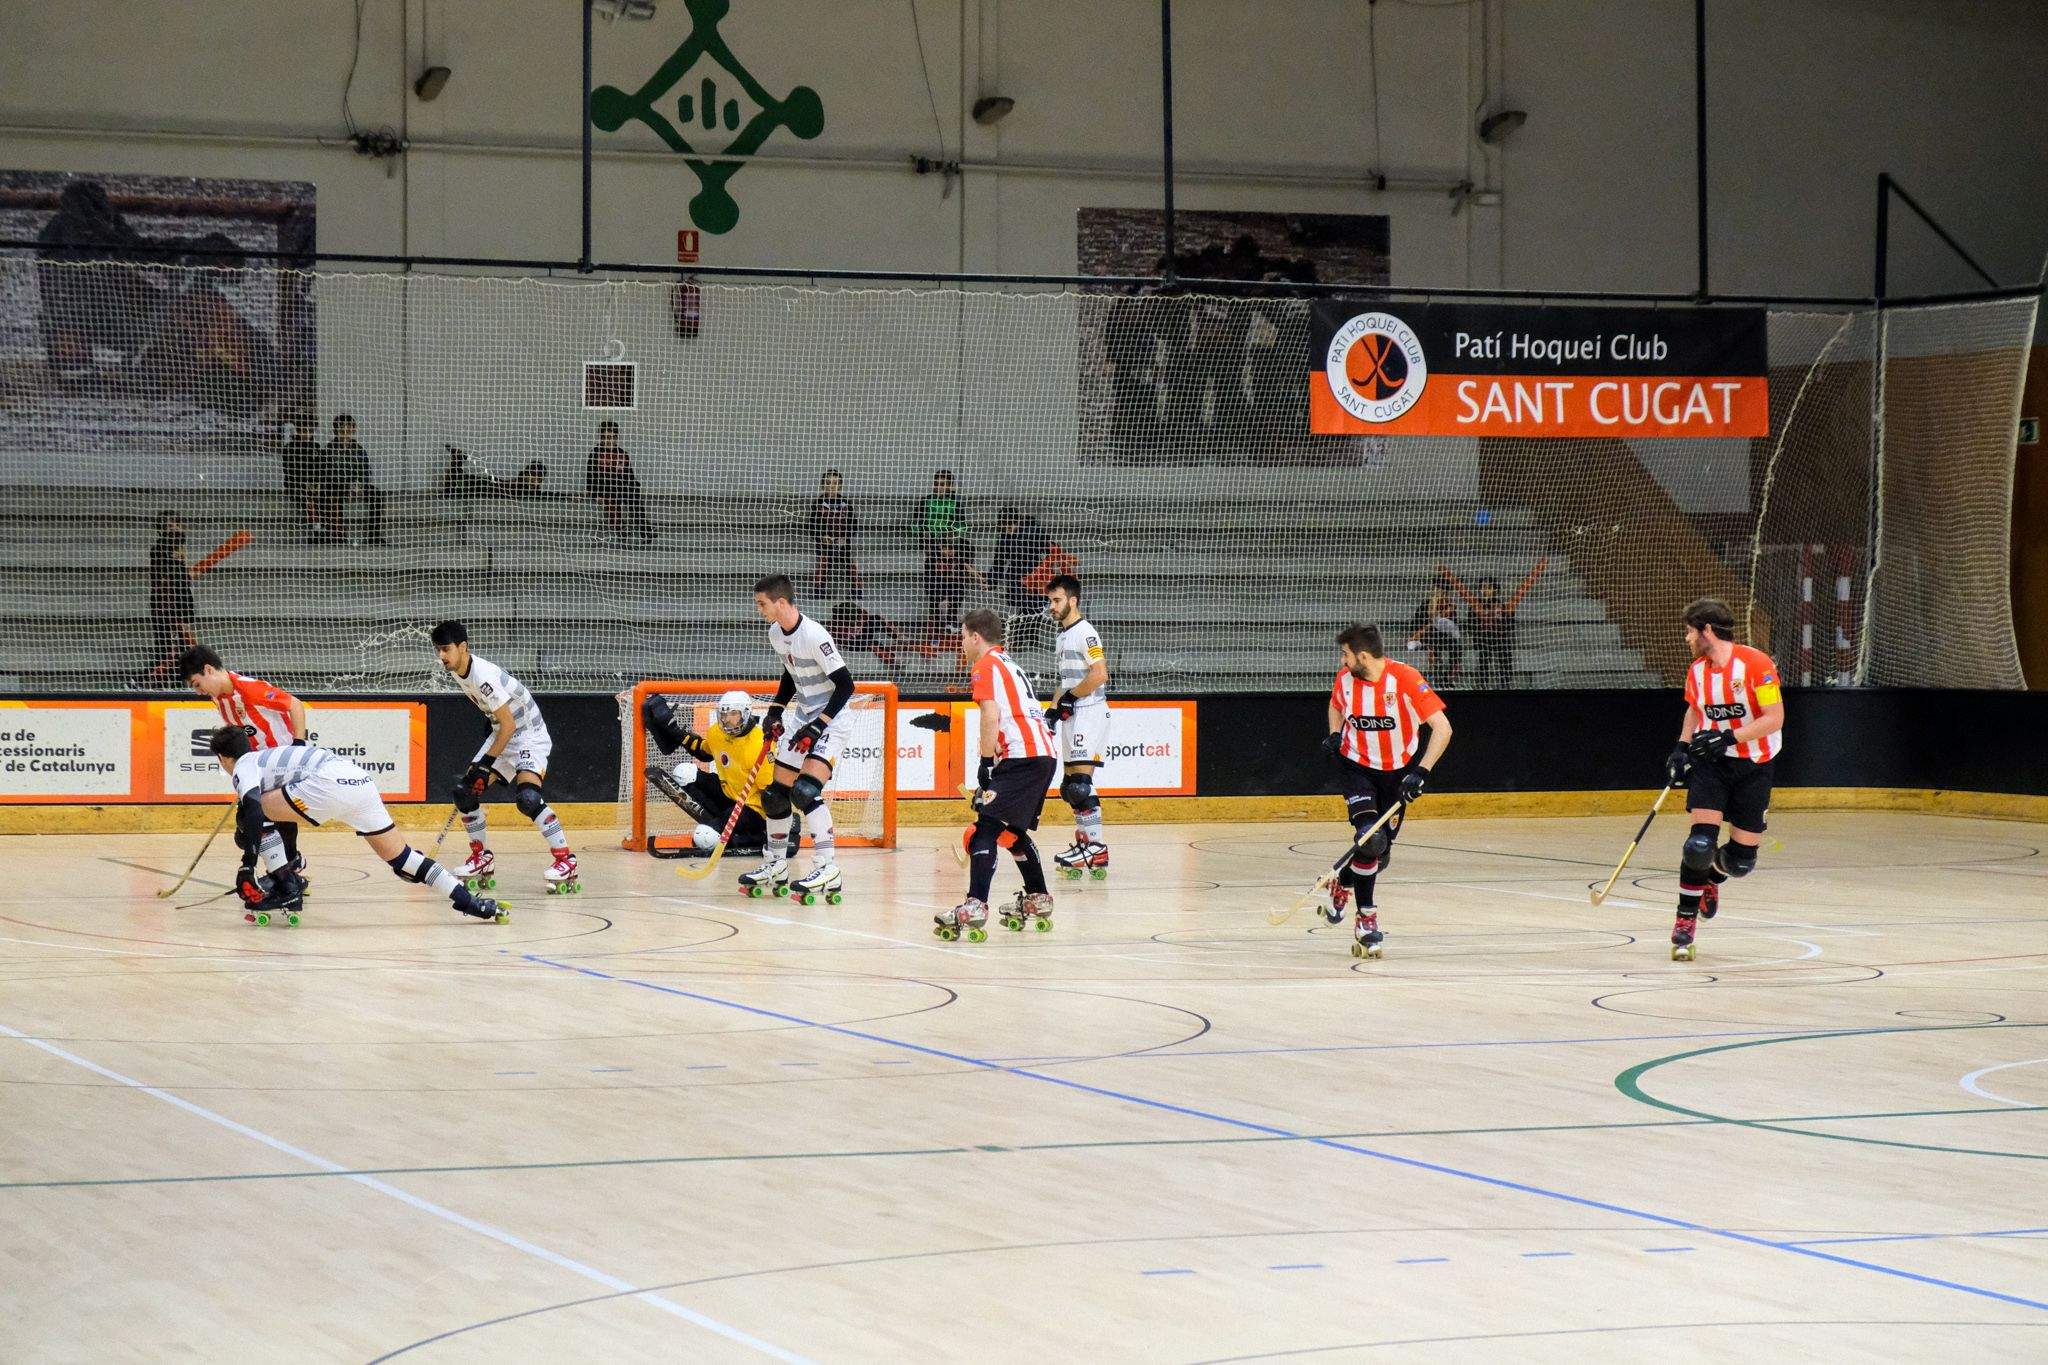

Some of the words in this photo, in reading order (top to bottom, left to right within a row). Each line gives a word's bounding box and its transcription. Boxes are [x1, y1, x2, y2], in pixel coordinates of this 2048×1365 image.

[1348, 317, 1398, 338] HOQUEI
[1399, 330, 1421, 364] CLUB
[1455, 332, 1502, 359] Patí
[1511, 333, 1601, 364] Hoquei
[1611, 334, 1668, 361] Club
[1338, 386, 1368, 414] SANT
[1374, 389, 1415, 418] CUGAT
[1456, 380, 1574, 423] SANT
[1590, 382, 1741, 424] CUGAT
[15, 729, 36, 741] de
[1073, 733, 1084, 747] 12
[1105, 743, 1170, 761] sportcat
[5, 760, 26, 772] de
[29, 759, 116, 775] Catalunya
